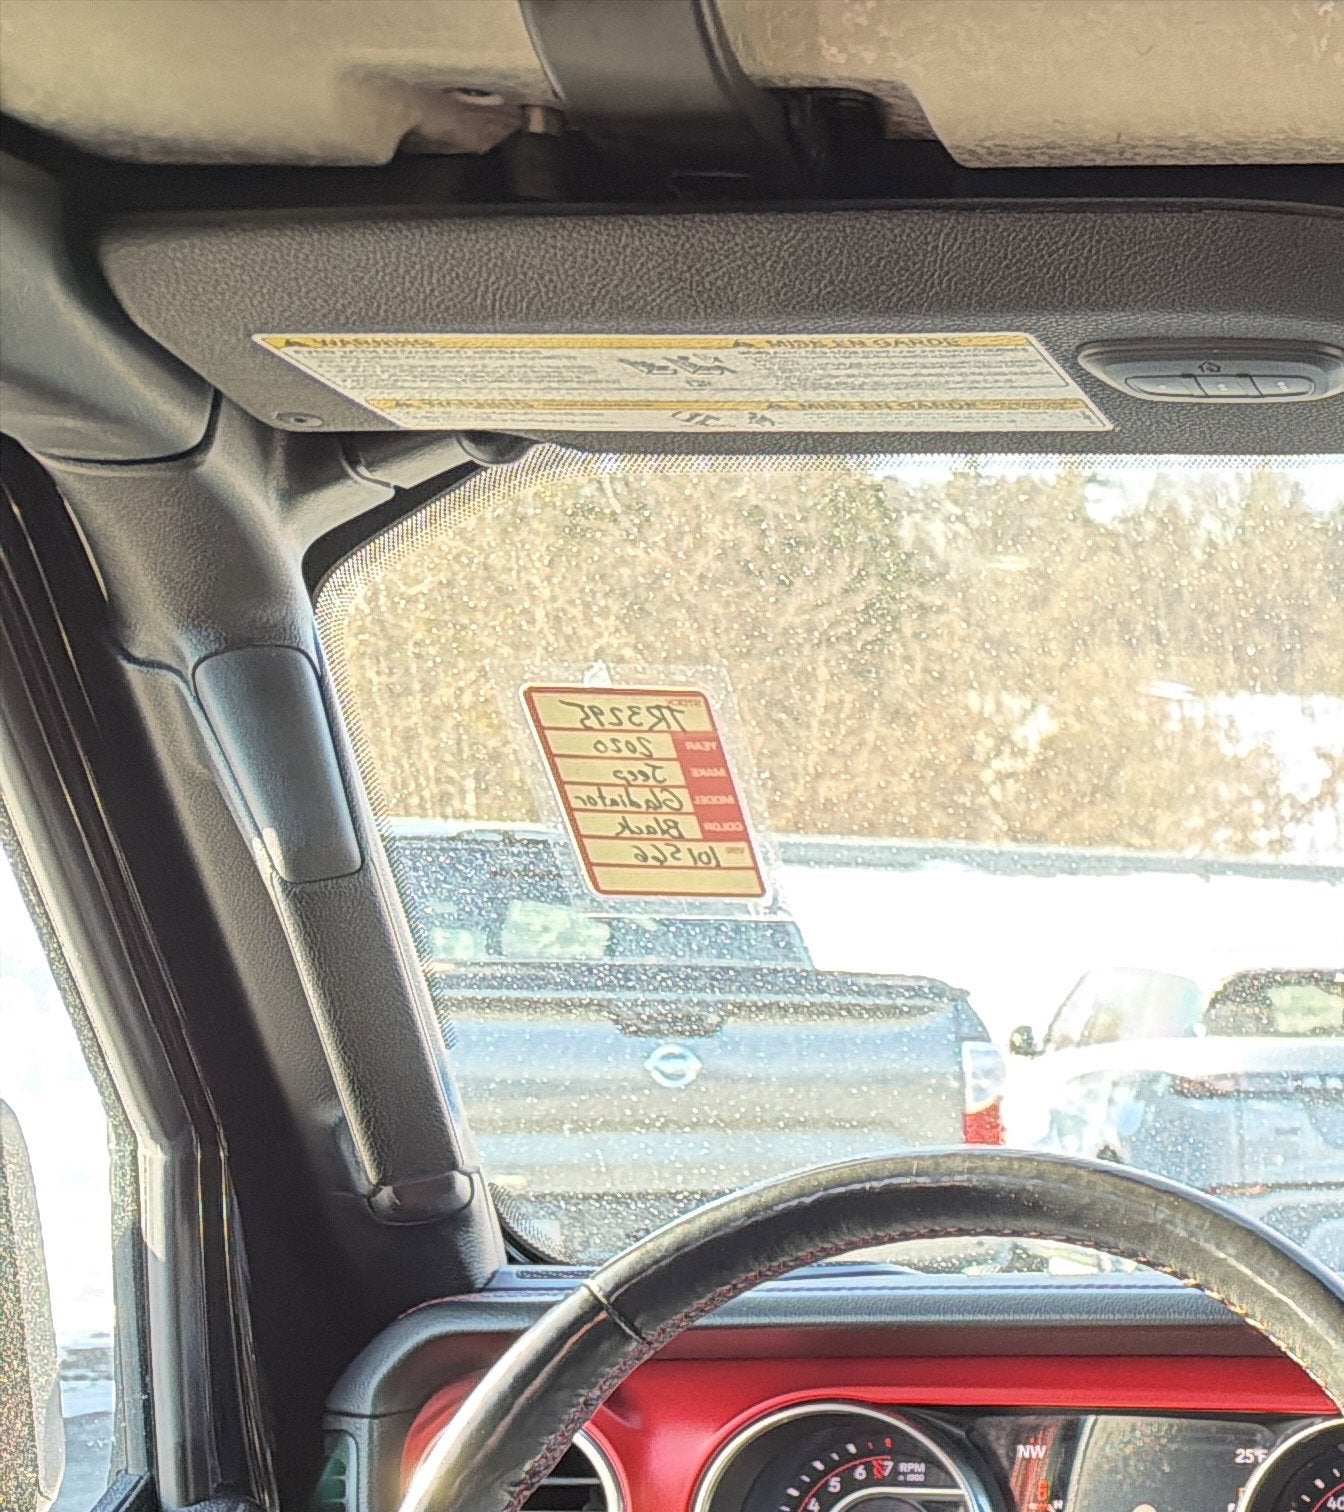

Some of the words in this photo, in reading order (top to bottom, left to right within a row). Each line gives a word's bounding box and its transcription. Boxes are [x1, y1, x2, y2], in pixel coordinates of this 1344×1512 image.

[1017, 1444, 1047, 1459] NW
[853, 1465, 867, 1481] 6
[883, 1461, 895, 1477] 7
[900, 1462, 926, 1473] RPM
[827, 1477, 841, 1493] 5
